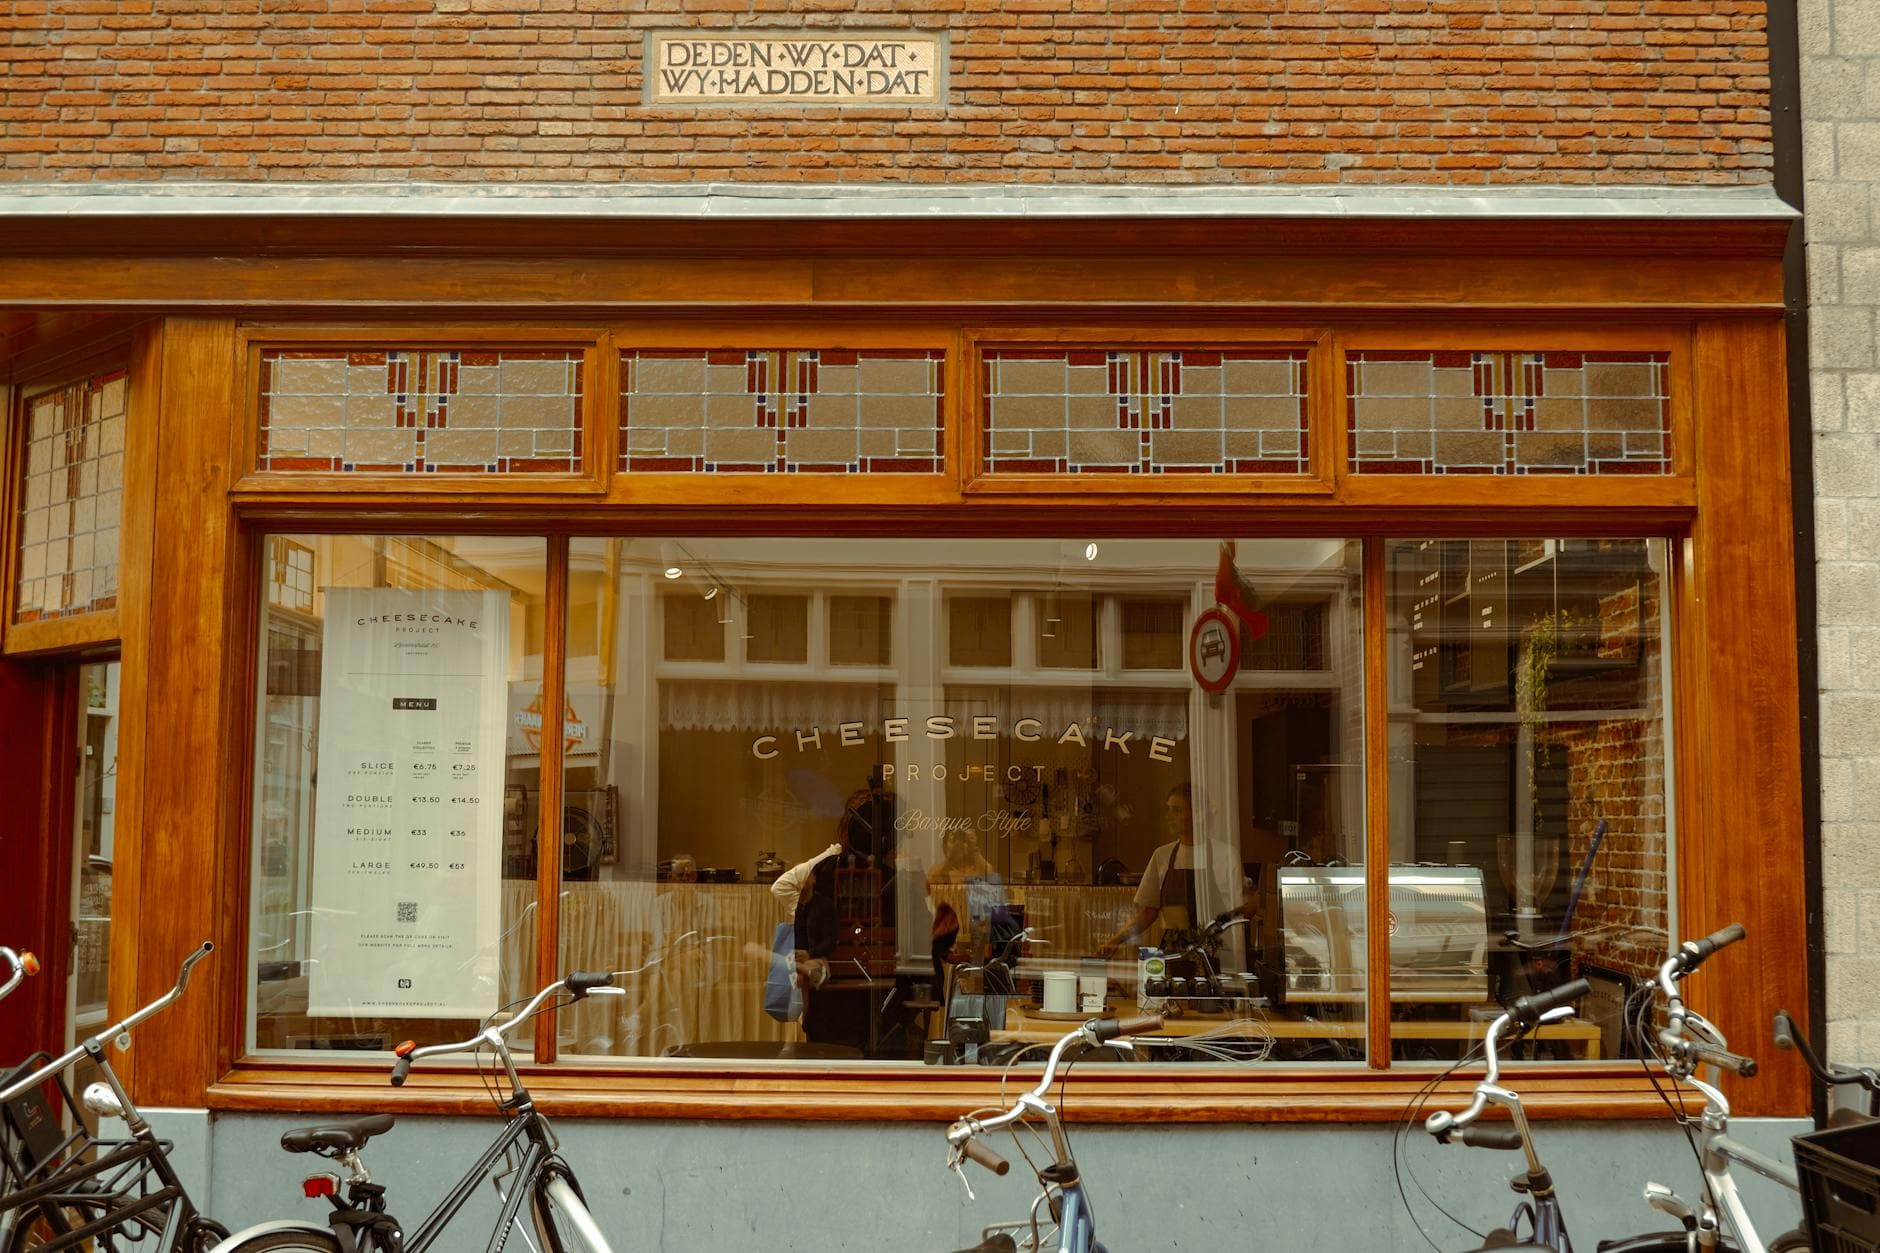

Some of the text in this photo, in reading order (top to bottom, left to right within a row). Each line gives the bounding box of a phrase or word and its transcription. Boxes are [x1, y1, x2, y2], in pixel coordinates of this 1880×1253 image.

[357, 614, 478, 629] CHEESECAKE
[751, 715, 1177, 763] CHEESECAKE
[882, 764, 1046, 783] PROJECT
[894, 808, 1033, 838] Basque Style
[352, 861, 391, 869] LARGE
